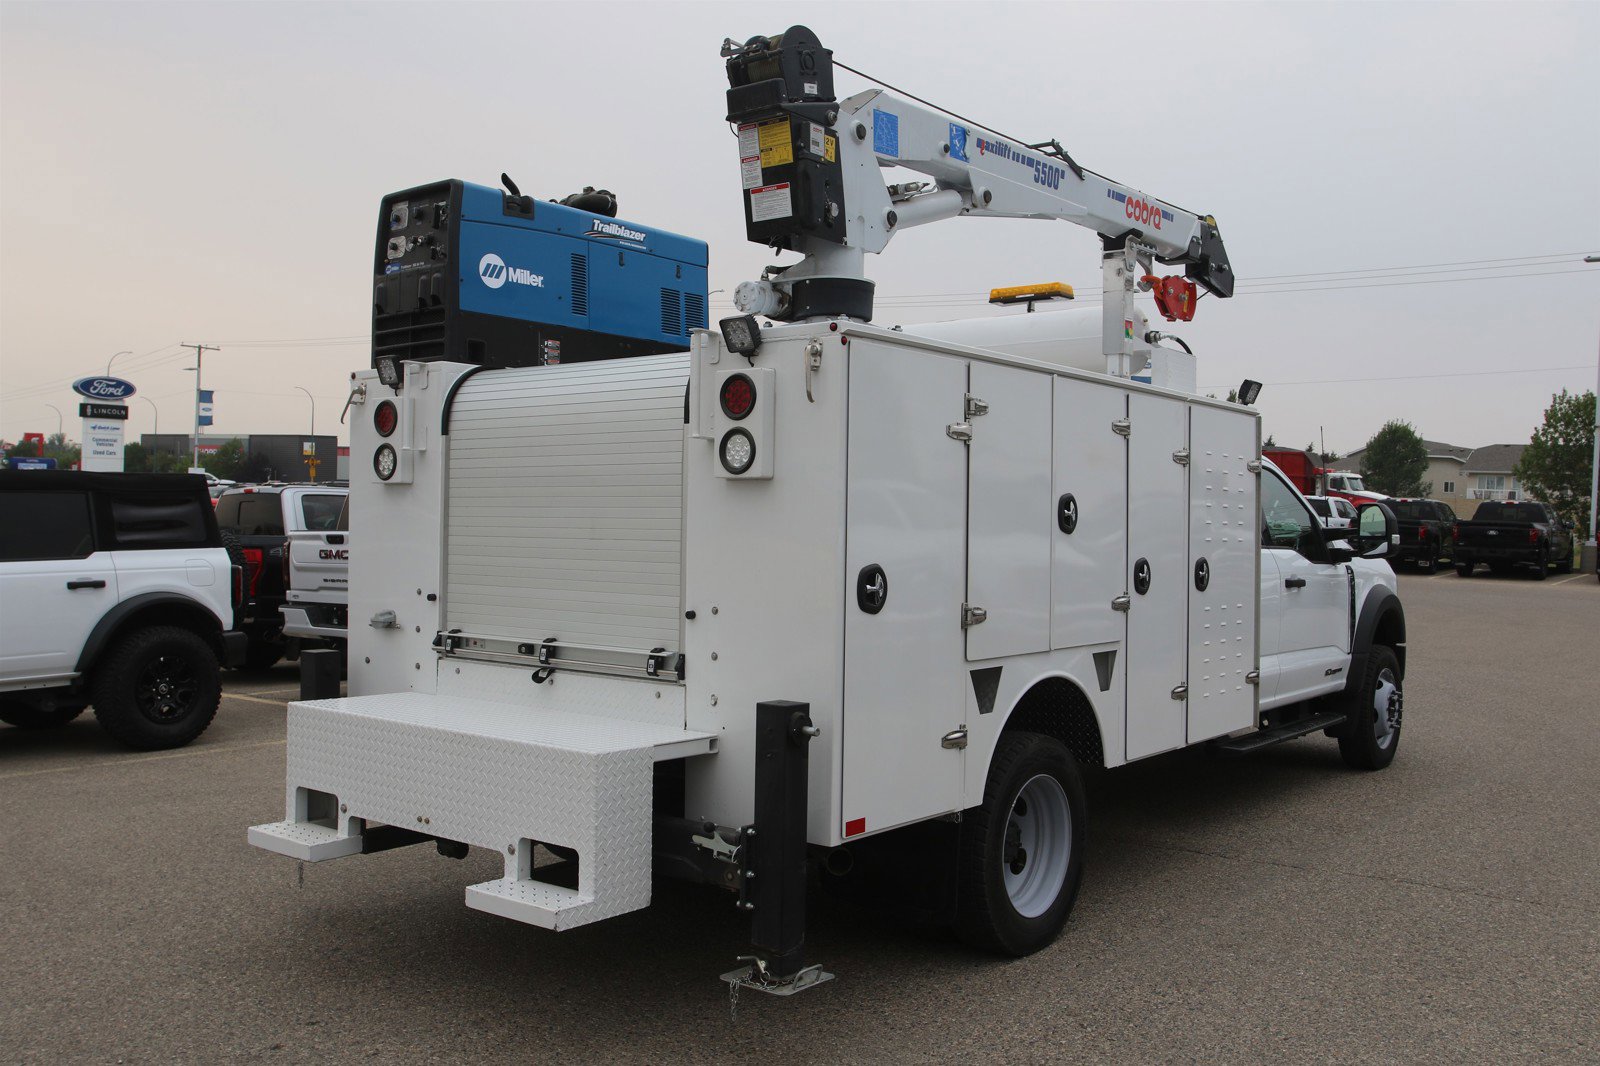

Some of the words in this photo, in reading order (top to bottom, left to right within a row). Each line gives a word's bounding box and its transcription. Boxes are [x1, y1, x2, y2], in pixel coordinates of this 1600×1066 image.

[1034, 160, 1060, 190] 5500
[1126, 196, 1161, 230] cobra
[593, 219, 646, 241] Trailblazer
[508, 266, 543, 287] Miller
[89, 380, 125, 396] Ford
[93, 408, 126, 416] LINCOLN
[319, 549, 348, 560] GMC
